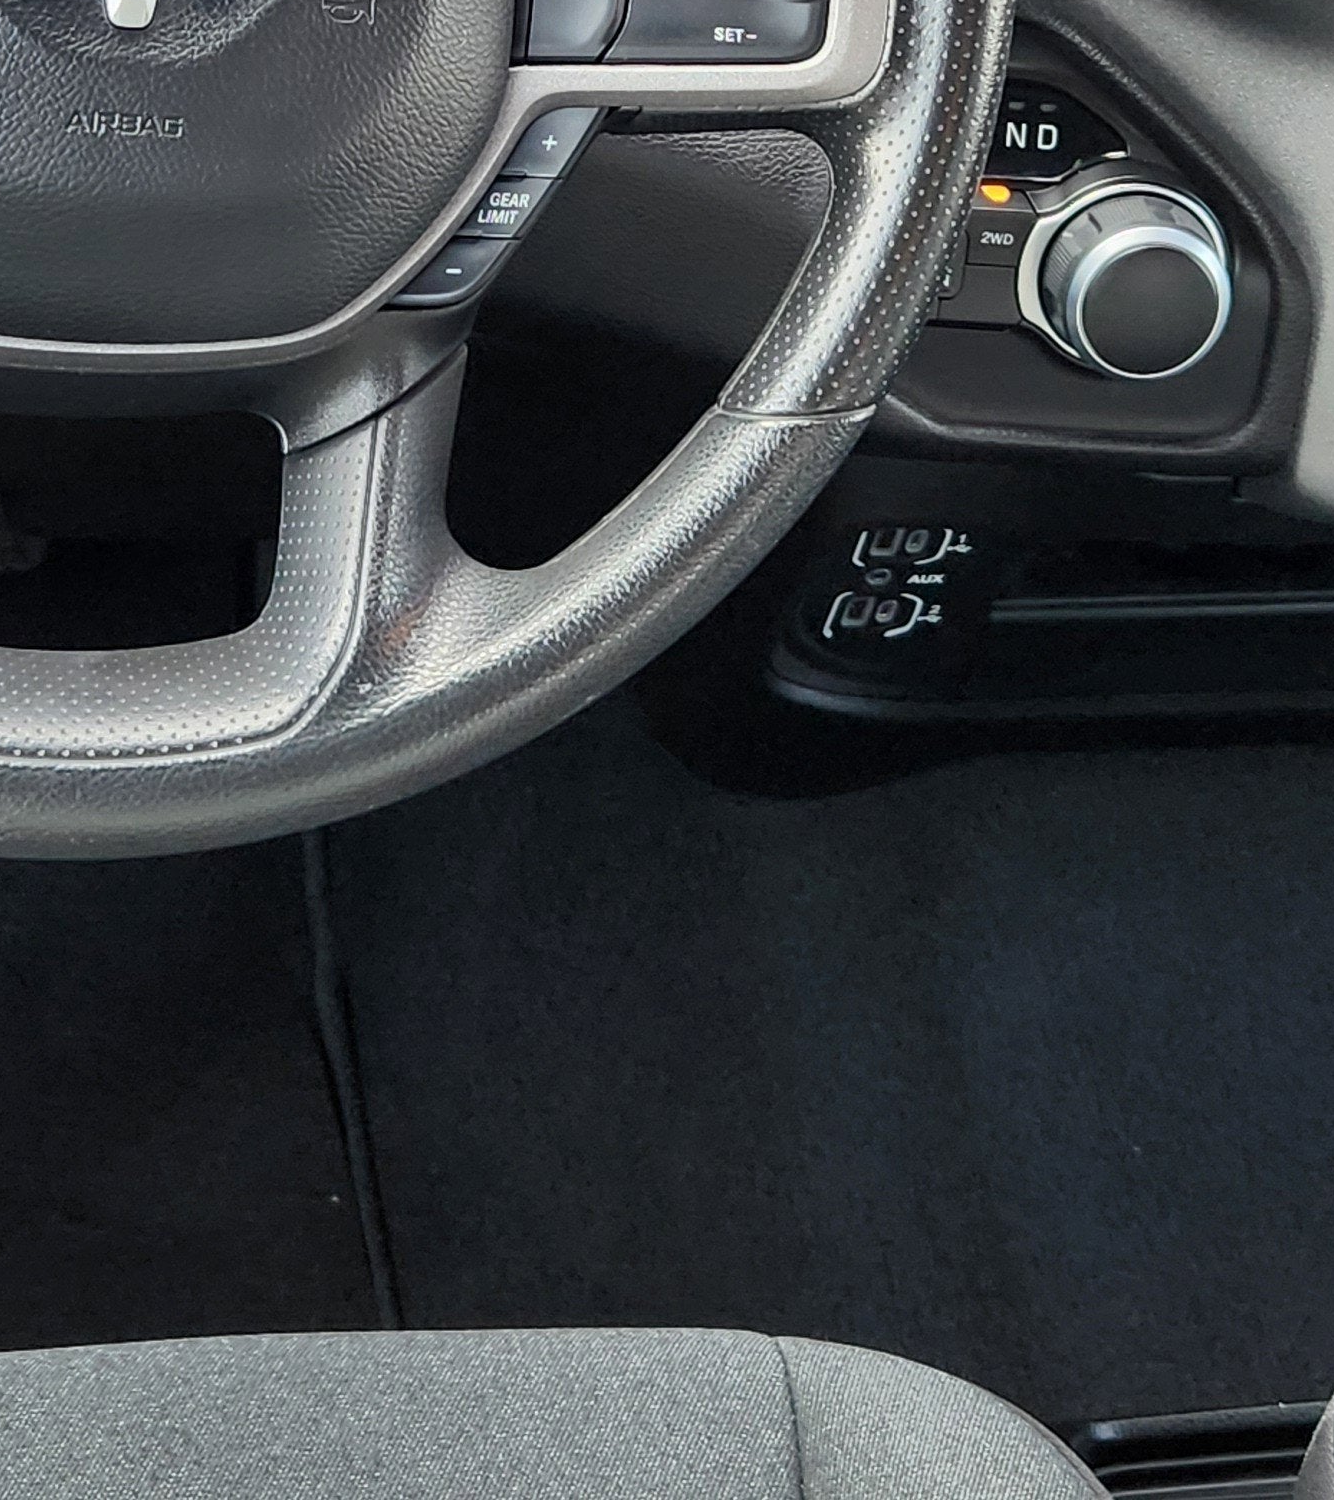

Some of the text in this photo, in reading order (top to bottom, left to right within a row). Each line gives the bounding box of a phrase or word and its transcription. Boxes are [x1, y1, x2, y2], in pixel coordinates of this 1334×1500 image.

[67, 111, 185, 140] AIRBAG
[1005, 122, 1058, 150] N D
[489, 192, 530, 208] GEAR
[477, 209, 519, 225] LIMIT
[980, 231, 1014, 246] 2WD
[906, 574, 946, 584] AUX
[928, 604, 941, 615] 2
